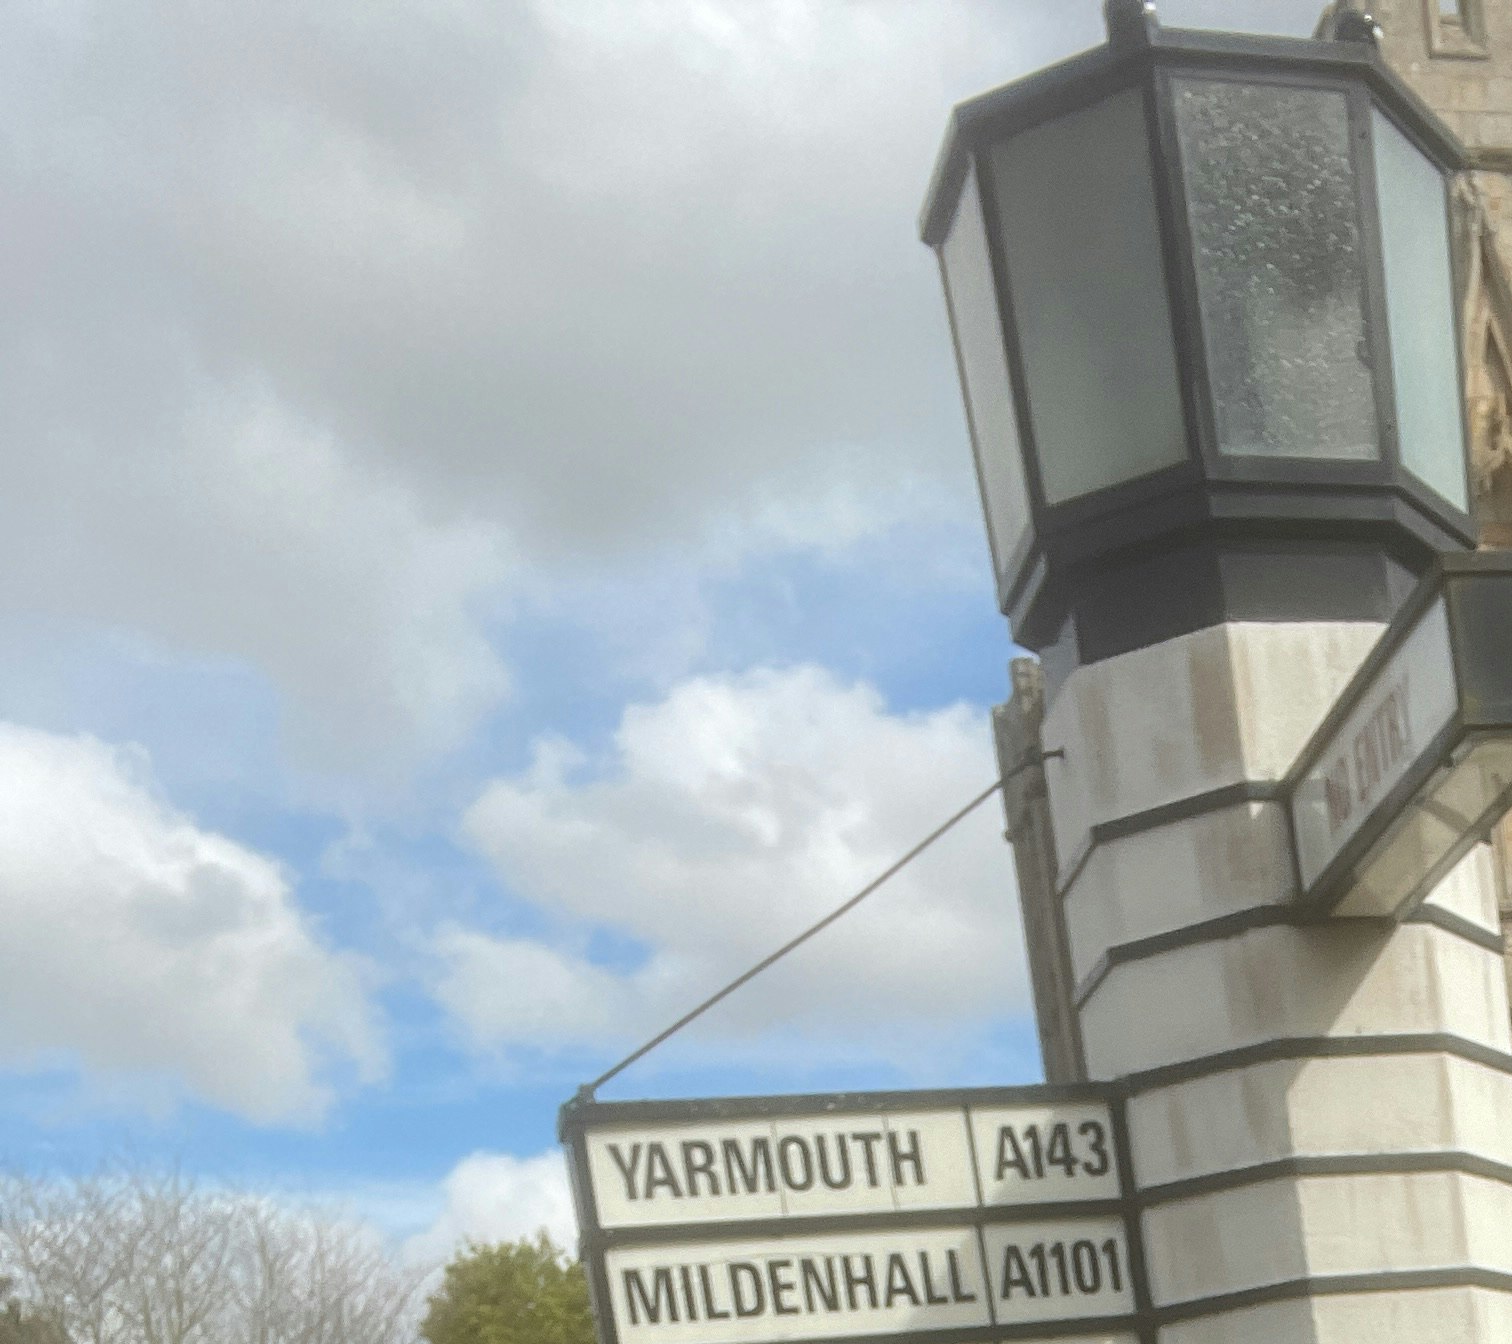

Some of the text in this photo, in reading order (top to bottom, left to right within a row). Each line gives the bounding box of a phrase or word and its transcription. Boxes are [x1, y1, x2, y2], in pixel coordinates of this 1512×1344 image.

[607, 1120, 1110, 1200] YARMOUTH A143
[620, 1238, 1123, 1325] MILDENHALL A1101
